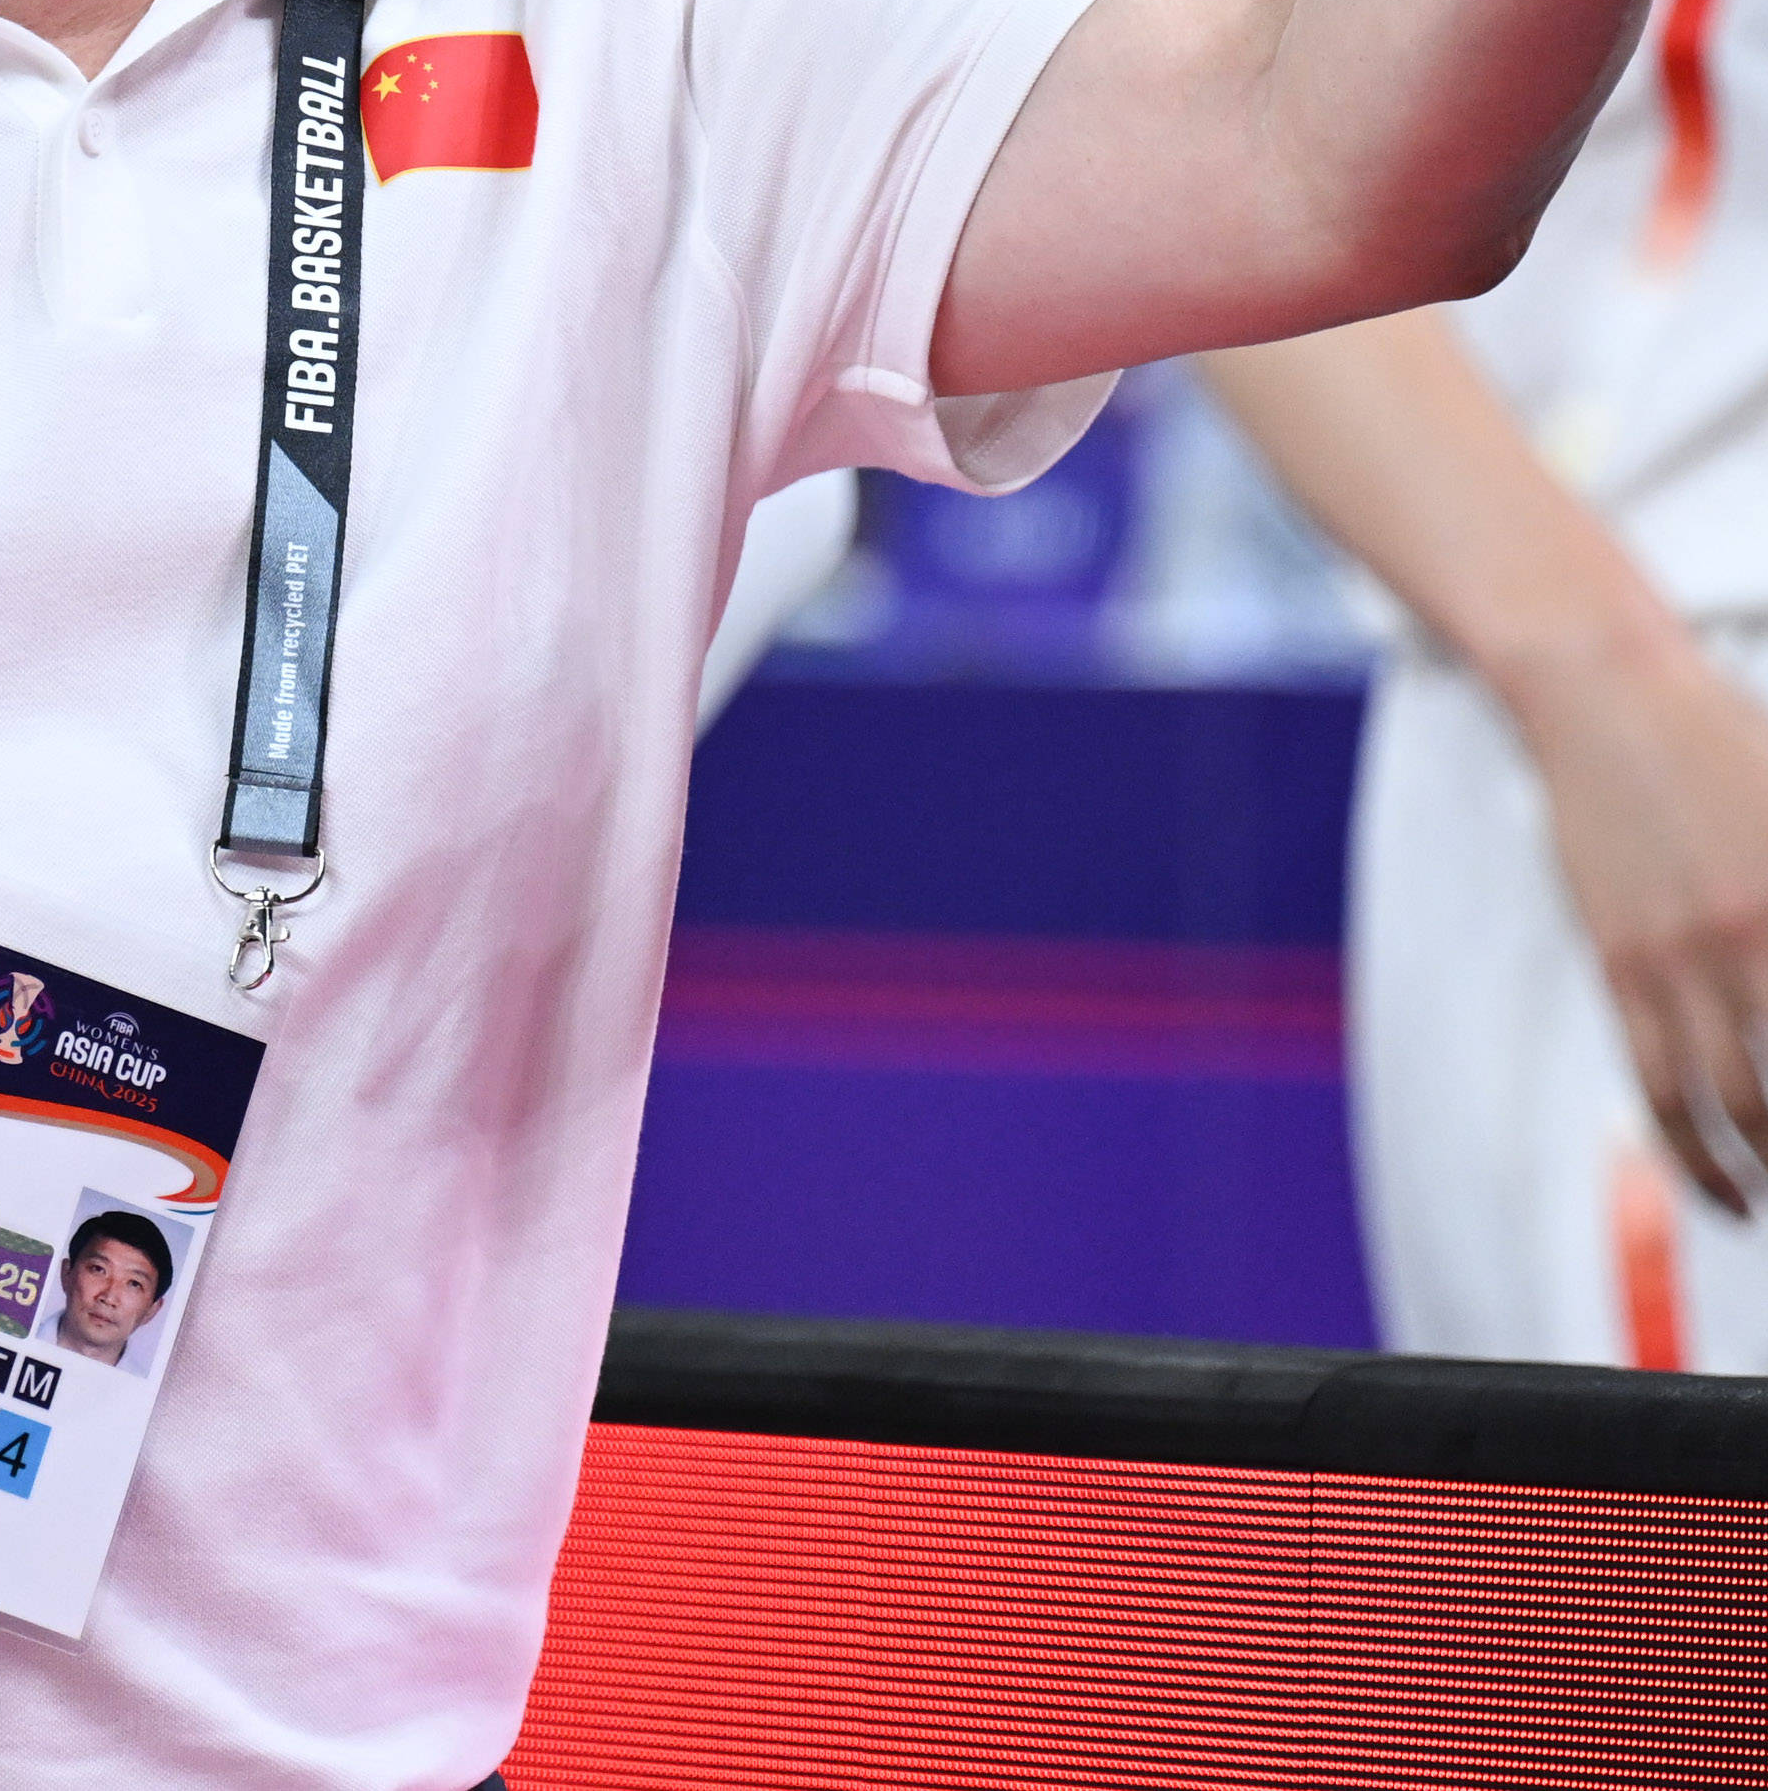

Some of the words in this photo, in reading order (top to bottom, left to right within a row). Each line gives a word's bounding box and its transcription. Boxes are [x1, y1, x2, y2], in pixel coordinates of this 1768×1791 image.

[284, 55, 347, 435] FIBA.BASKETBALL
[286, 541, 310, 575] PET
[282, 579, 306, 658] recycled
[275, 662, 297, 707] from
[269, 710, 294, 760] Made
[76, 1020, 160, 1061] WOMEN'S
[109, 1018, 134, 1037] FIBA
[54, 1031, 114, 1074] ASIA
[115, 1053, 167, 1090] CUP
[50, 1061, 111, 1100] CHINA
[112, 1084, 159, 1113] 2025
[19, 1364, 54, 1402] M
